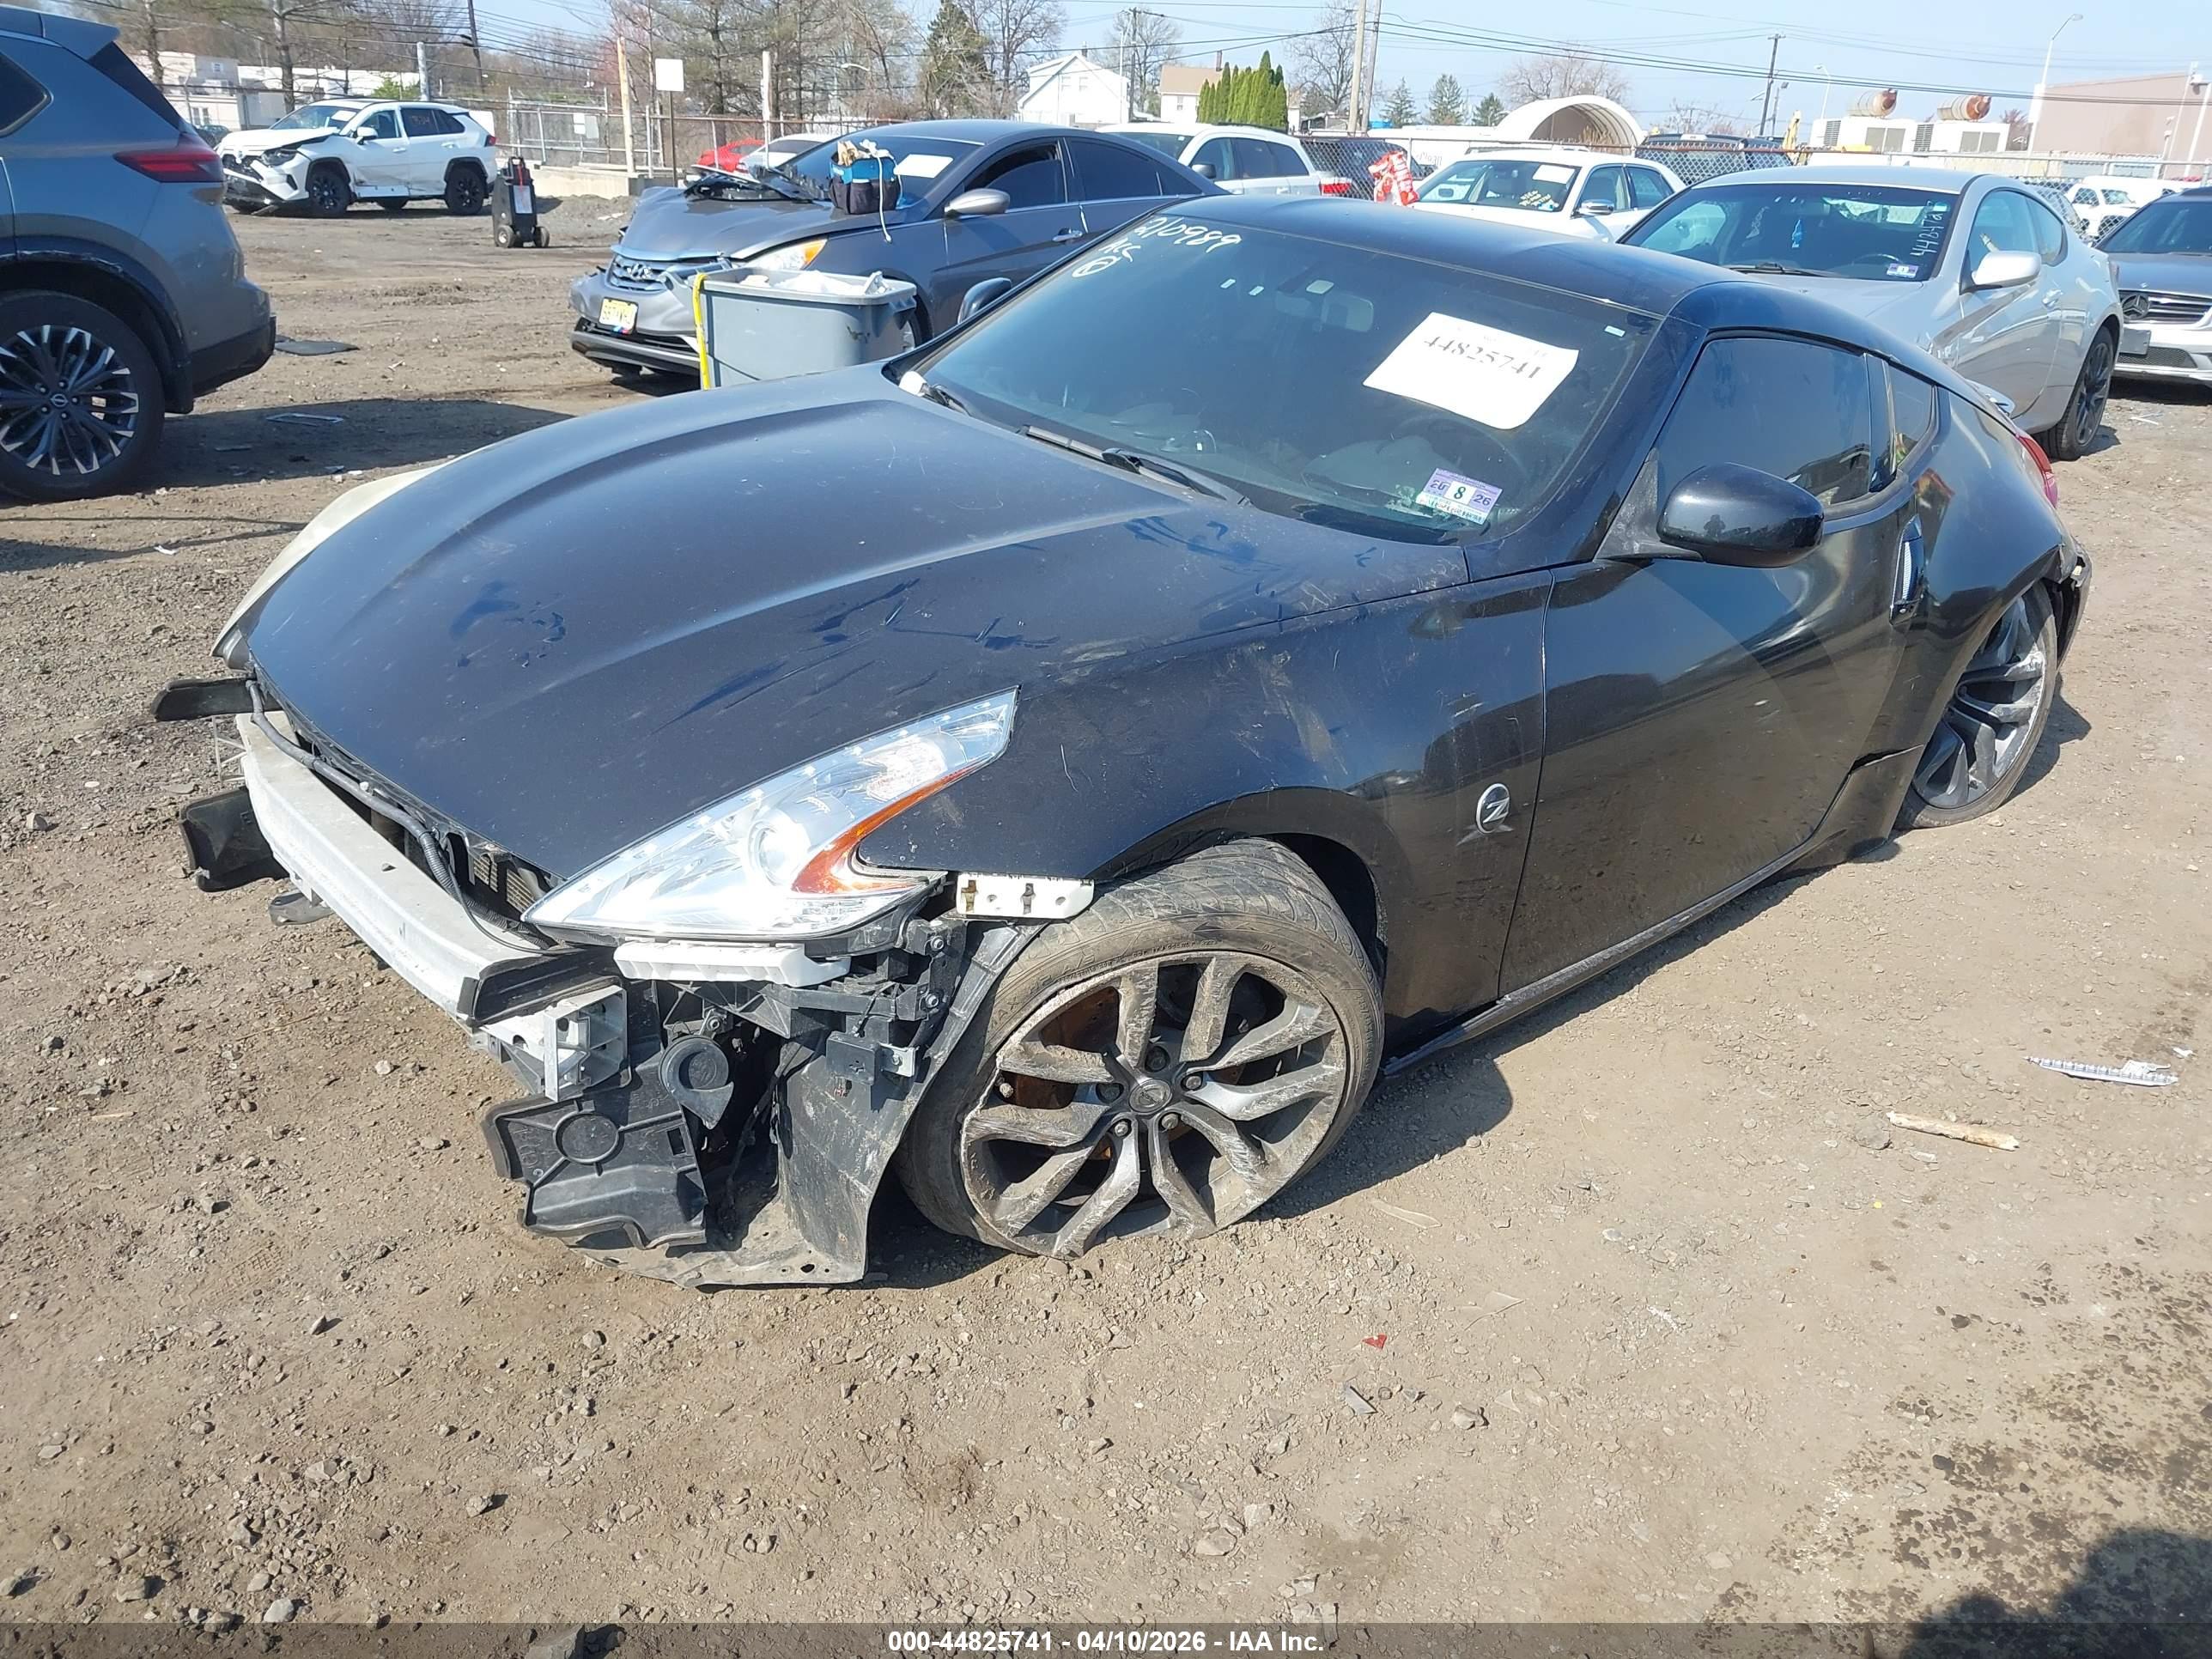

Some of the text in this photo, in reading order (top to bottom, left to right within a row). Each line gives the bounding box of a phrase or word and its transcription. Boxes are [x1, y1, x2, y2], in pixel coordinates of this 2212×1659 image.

[1423, 336, 1542, 379] 44825741
[1453, 486, 1467, 500] 8
[1473, 494, 1492, 507] 26
